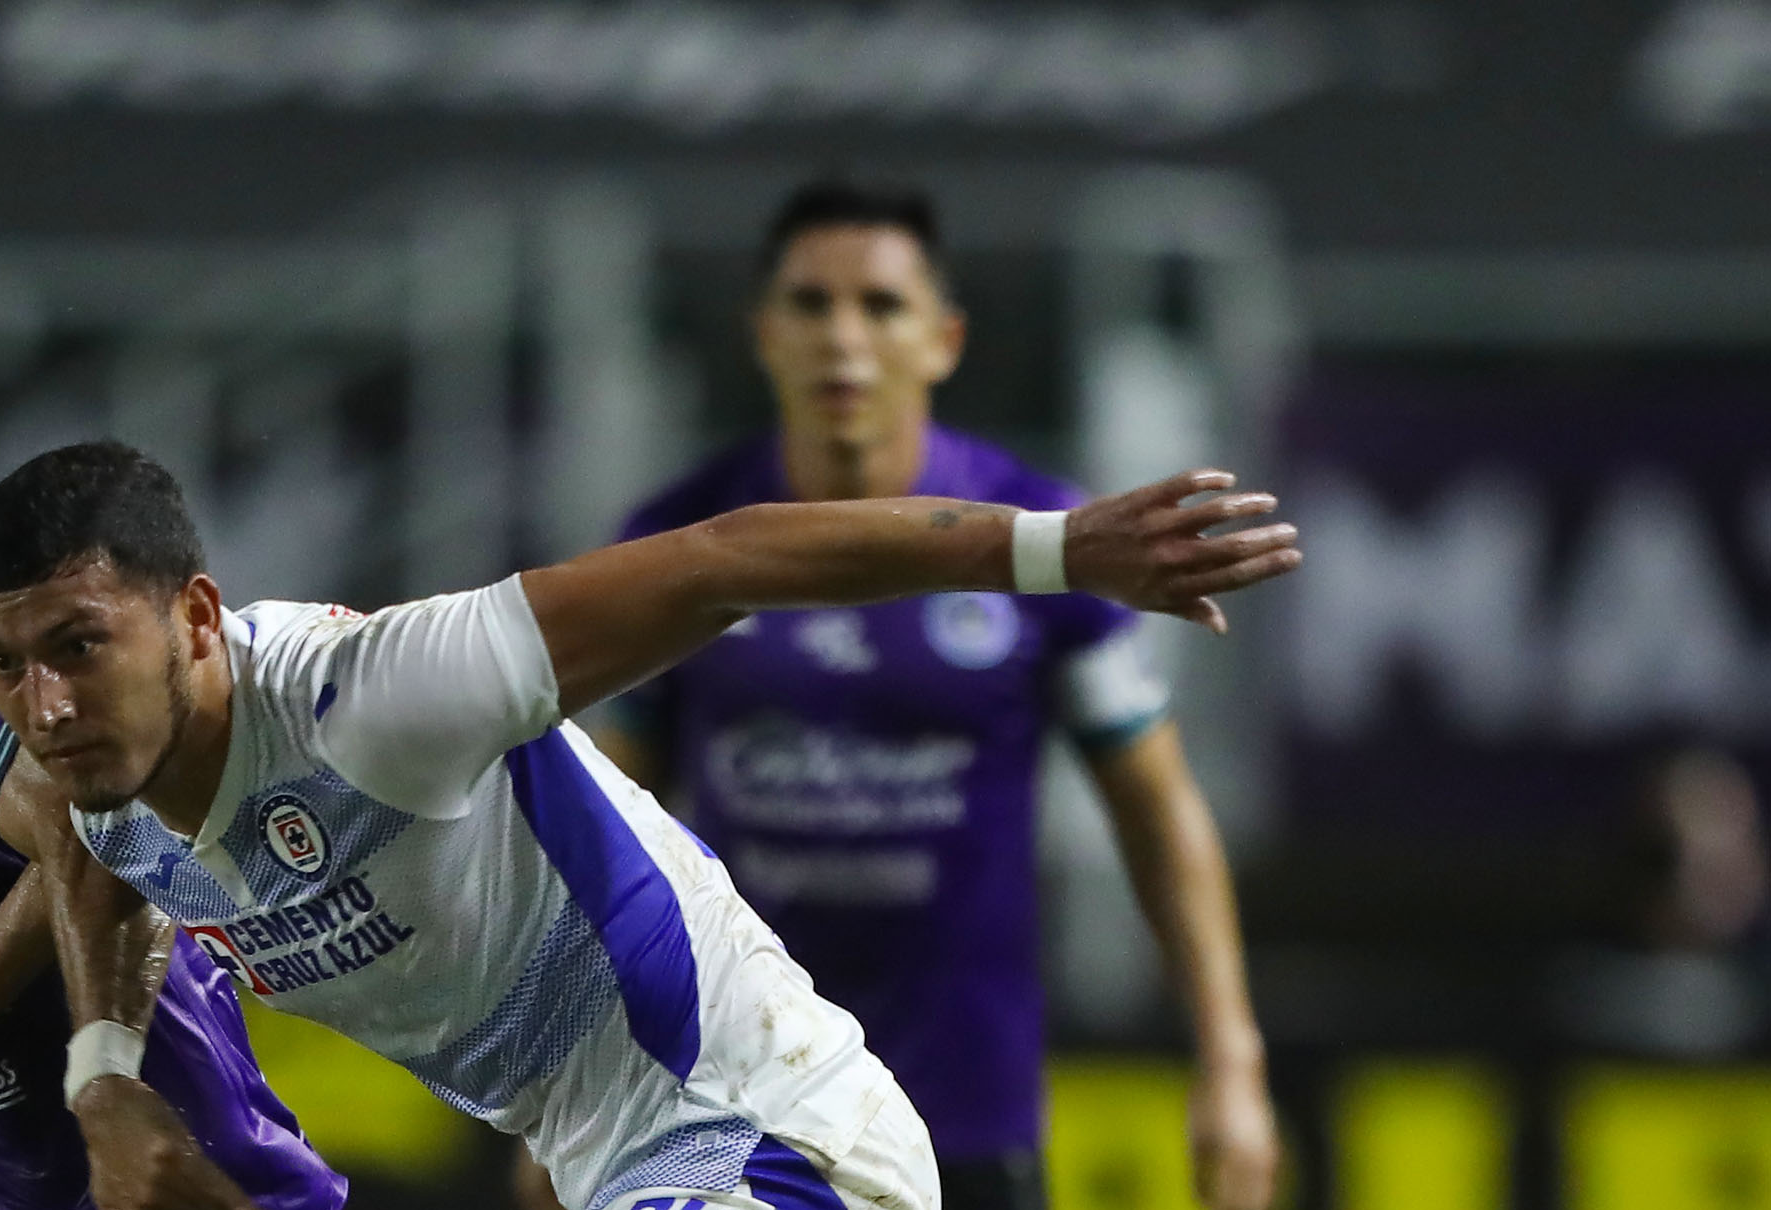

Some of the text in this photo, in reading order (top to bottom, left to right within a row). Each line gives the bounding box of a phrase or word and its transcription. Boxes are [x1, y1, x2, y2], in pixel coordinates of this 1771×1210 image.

[1296, 472, 1771, 738] MA
[225, 876, 375, 956] CEMENTO
[254, 911, 416, 993] CRUZ AZUL
